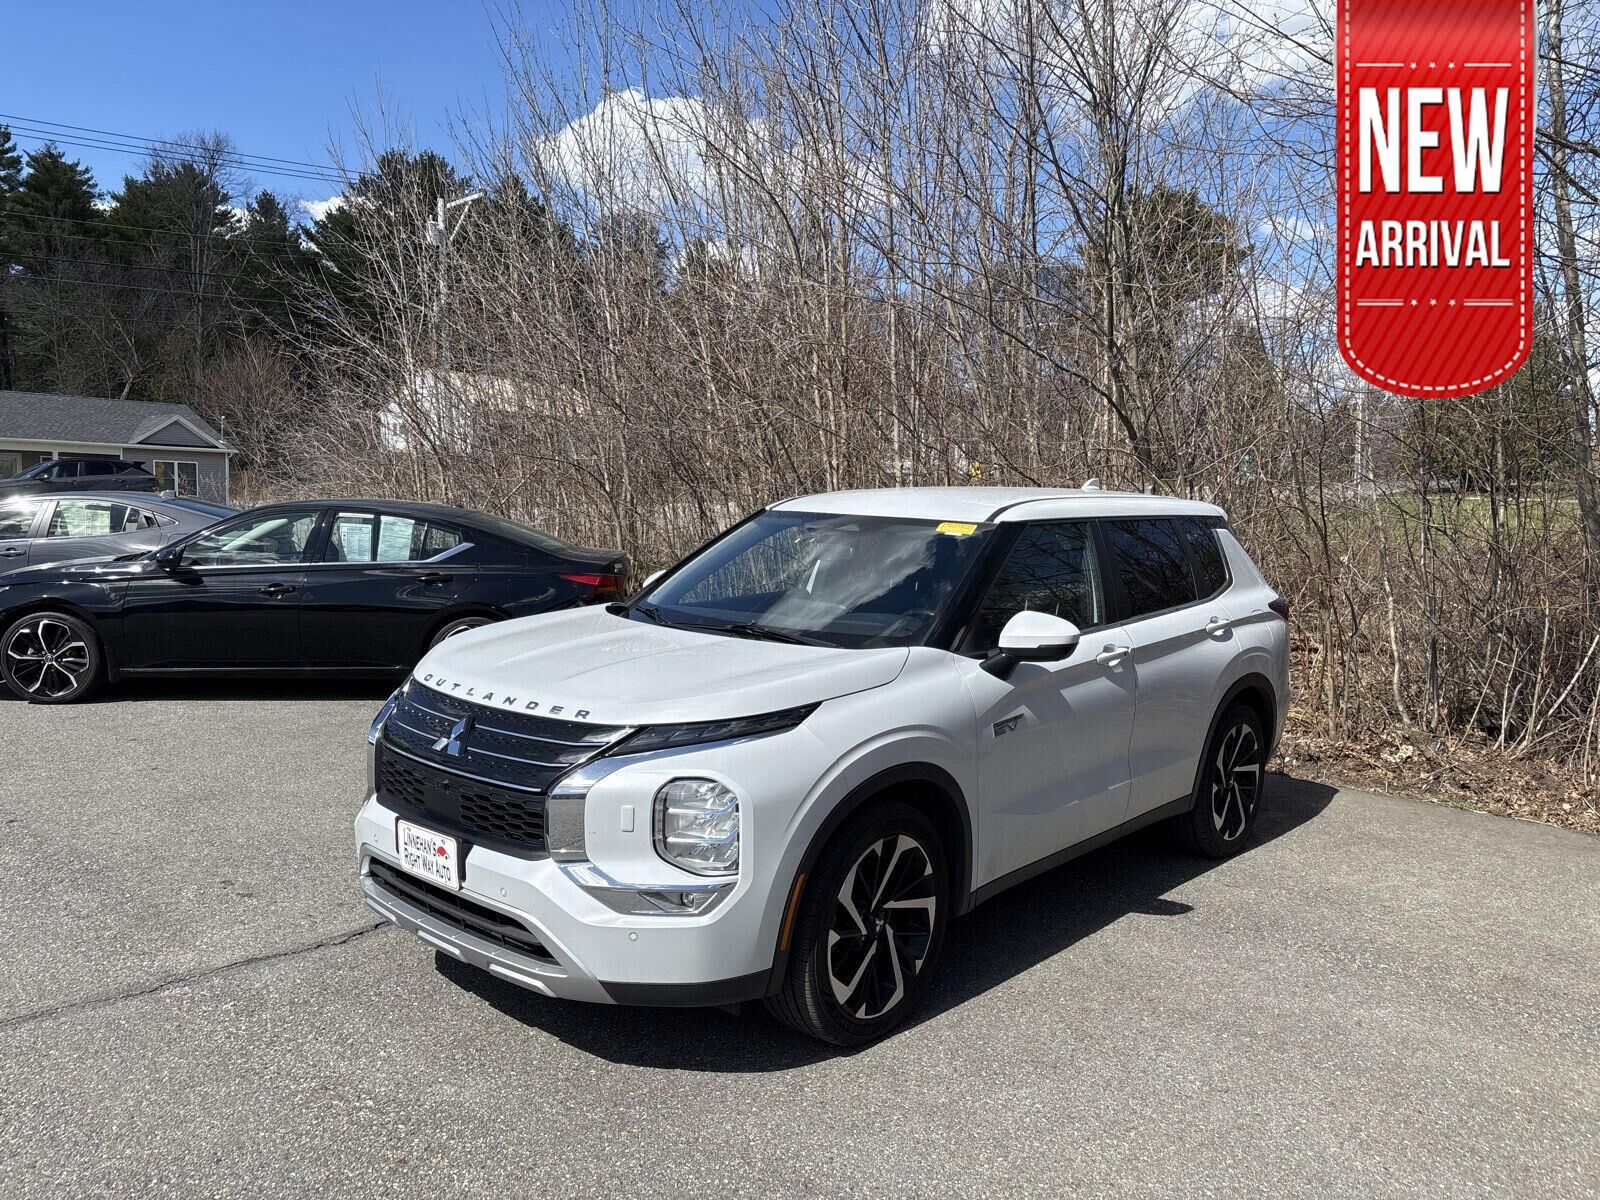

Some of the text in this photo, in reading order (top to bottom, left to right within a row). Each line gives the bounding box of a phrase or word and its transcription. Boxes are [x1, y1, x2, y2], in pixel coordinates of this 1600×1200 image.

[423, 673, 591, 720] OUTLANDER
[420, 854, 434, 875] WAY
[435, 860, 452, 882] AUTO
